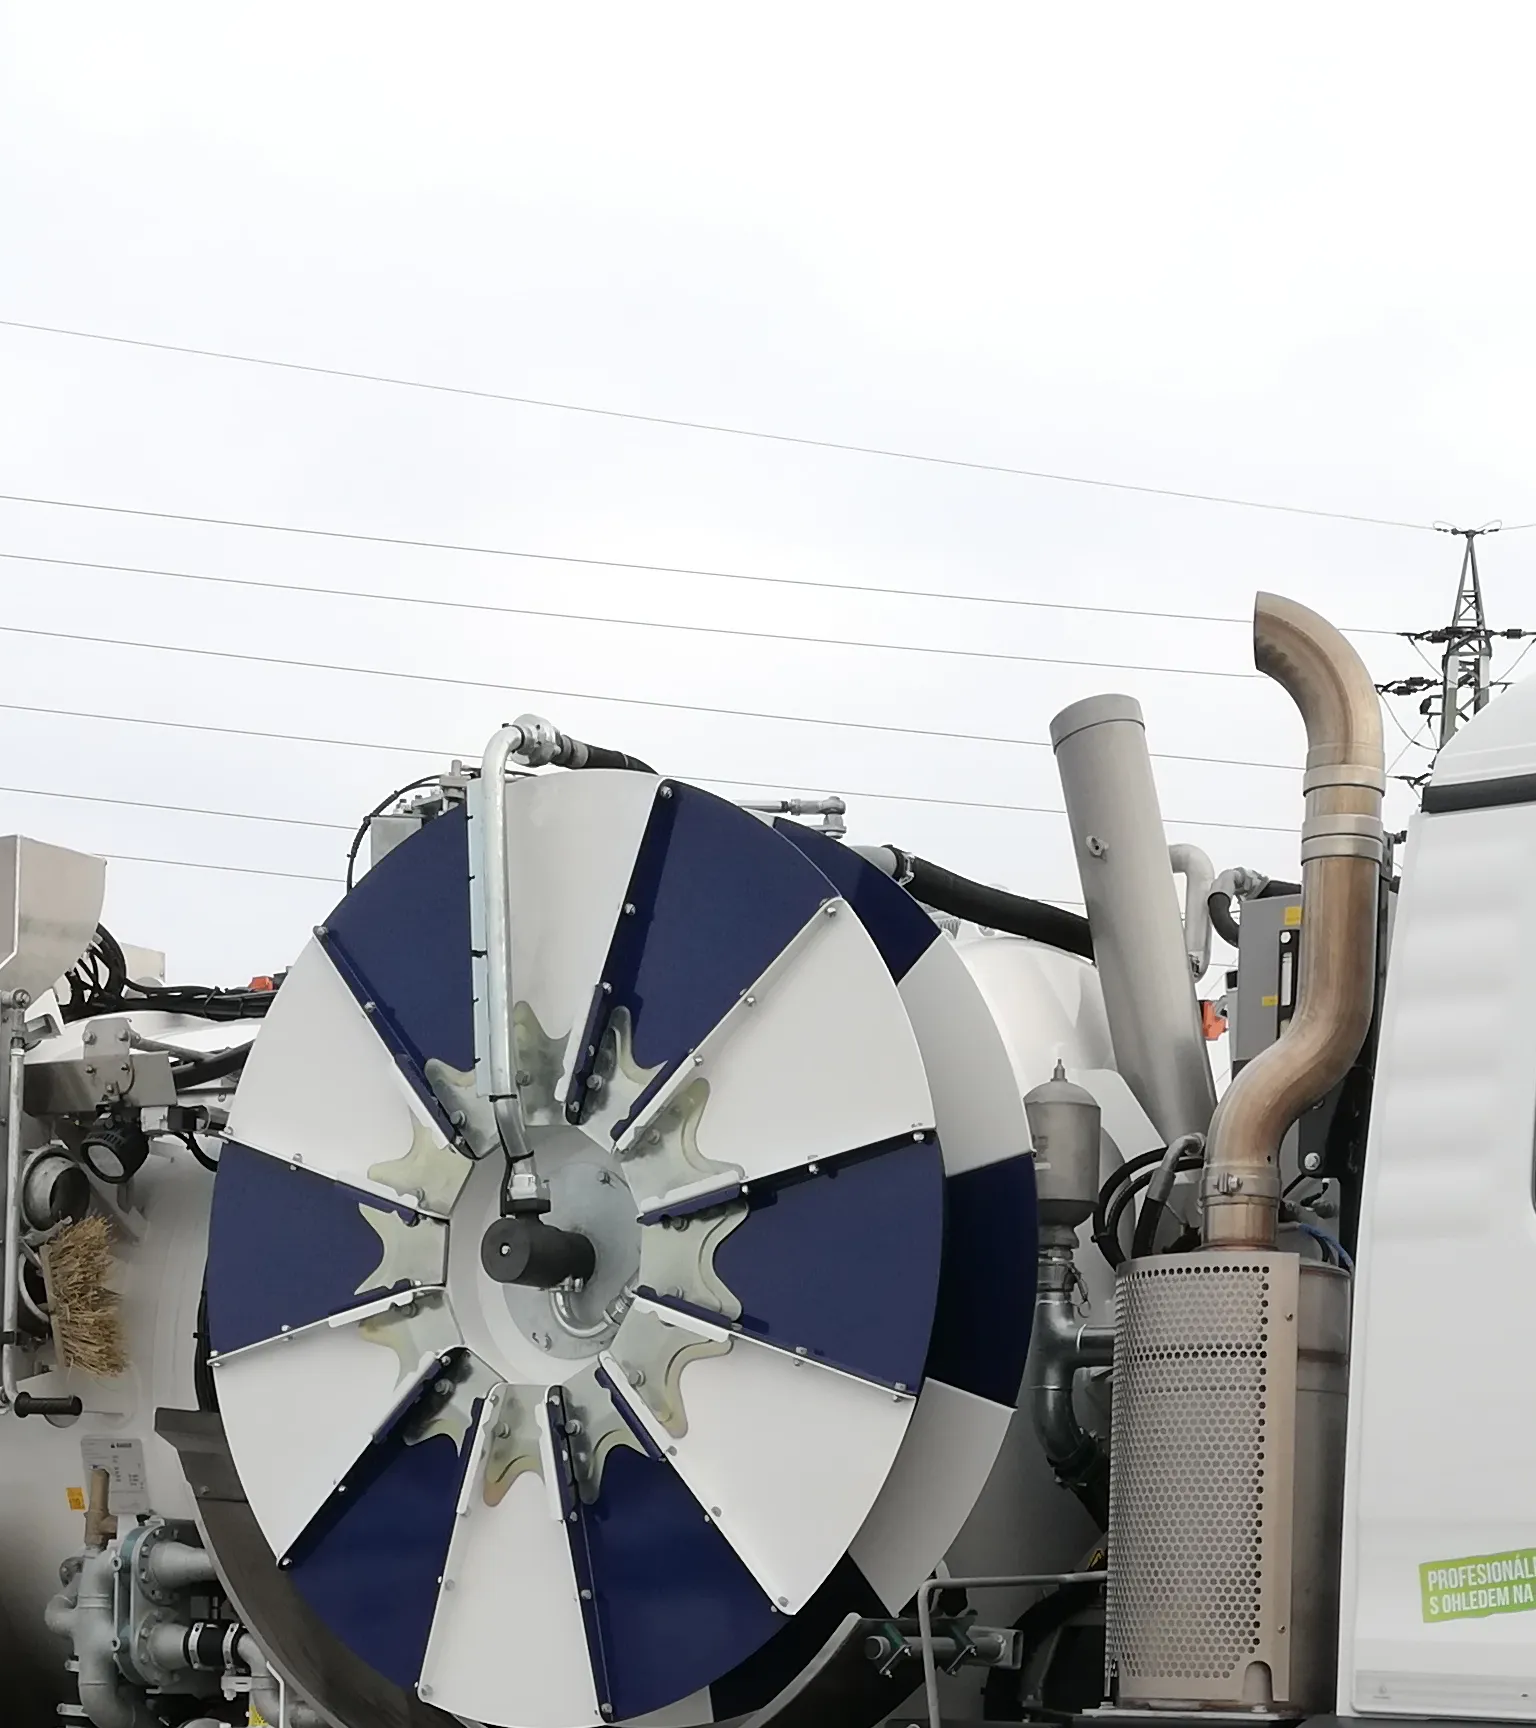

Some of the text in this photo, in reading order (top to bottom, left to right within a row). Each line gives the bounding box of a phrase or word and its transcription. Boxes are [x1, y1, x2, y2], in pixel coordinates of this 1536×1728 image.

[1429, 1595, 1440, 1616] S
[1442, 1585, 1510, 1613] OHLEDEM
[1512, 1583, 1534, 1605] NA
